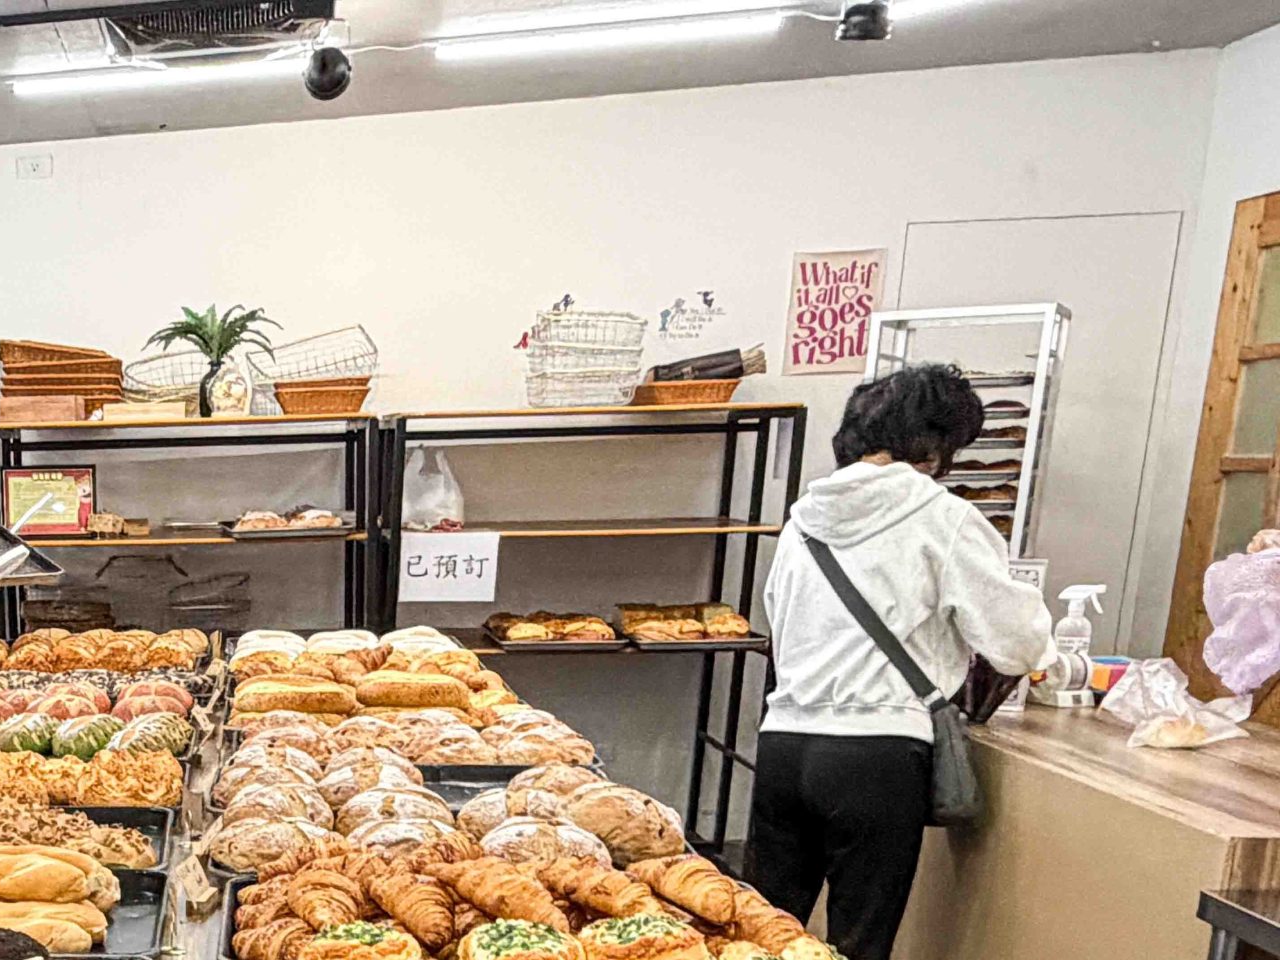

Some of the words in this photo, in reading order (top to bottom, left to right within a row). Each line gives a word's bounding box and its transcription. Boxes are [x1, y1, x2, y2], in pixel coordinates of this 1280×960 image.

[800, 260, 858, 286] What
[860, 262, 879, 289] if
[796, 287, 813, 308] it
[815, 284, 841, 306] all
[793, 294, 874, 340] goes
[792, 319, 869, 366] right
[407, 554, 490, 579] 已預訂
